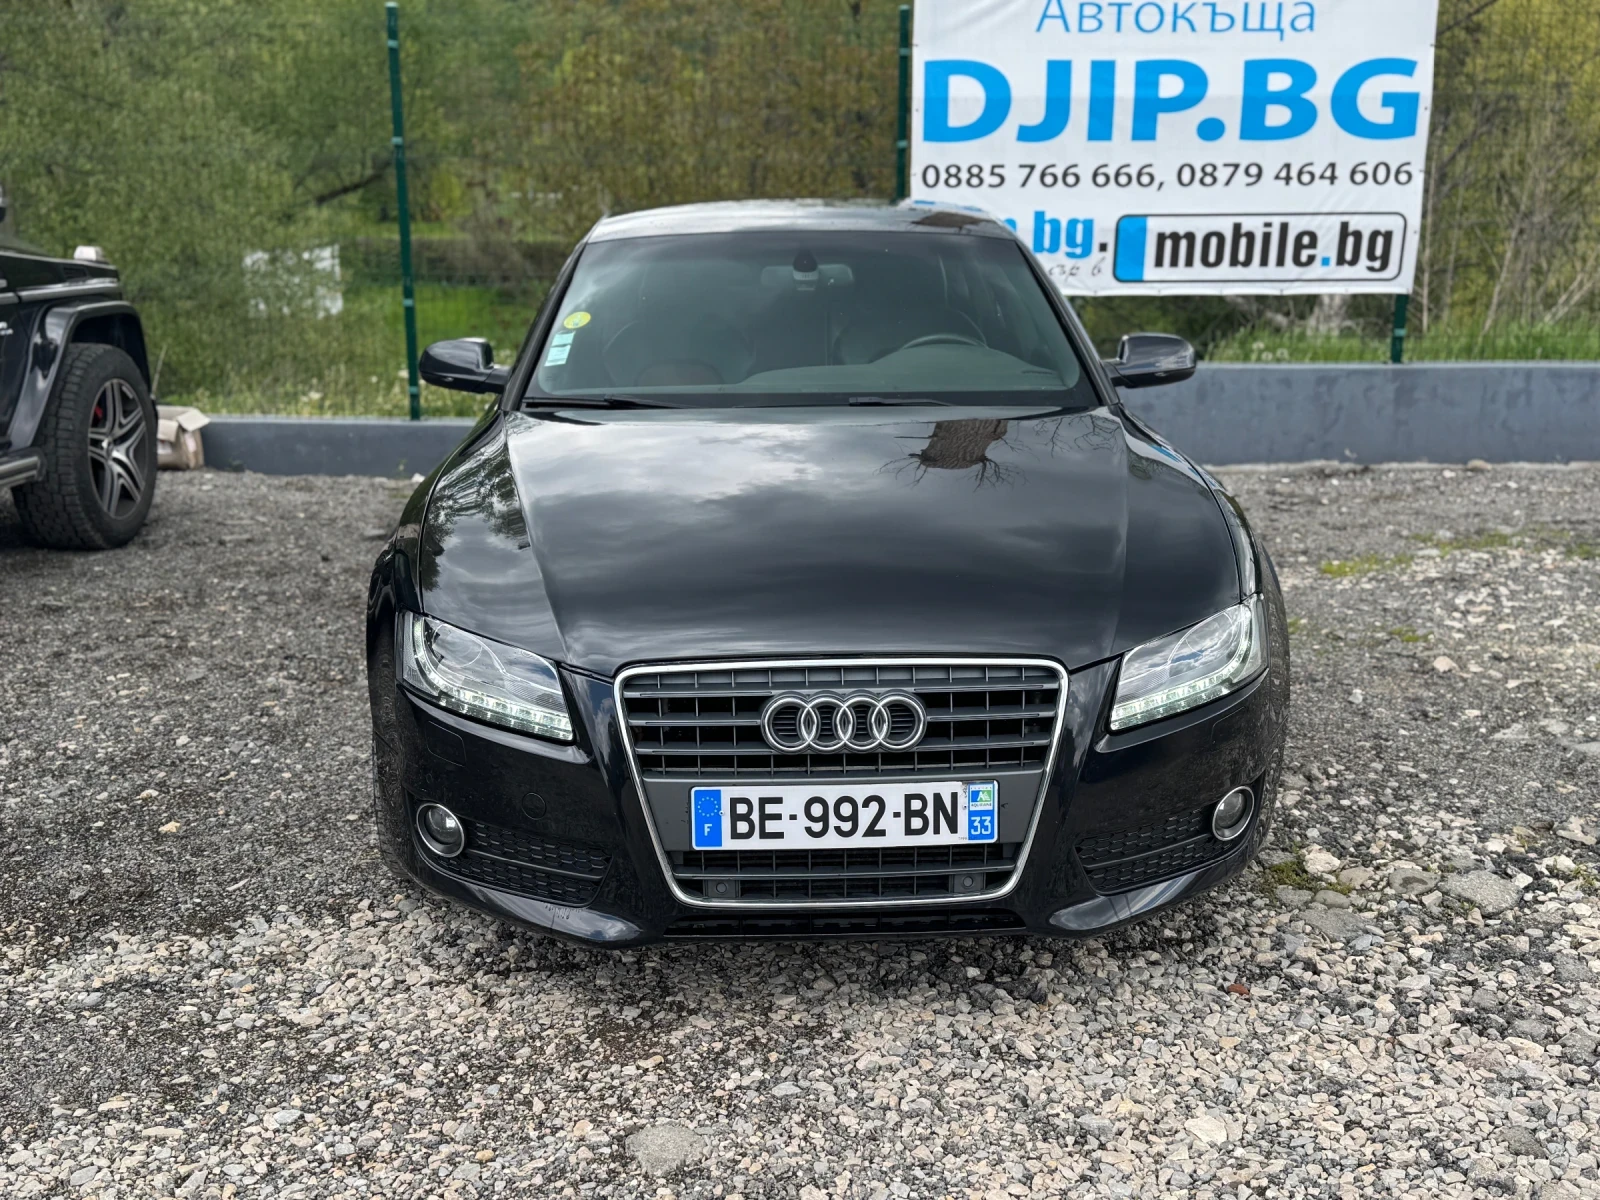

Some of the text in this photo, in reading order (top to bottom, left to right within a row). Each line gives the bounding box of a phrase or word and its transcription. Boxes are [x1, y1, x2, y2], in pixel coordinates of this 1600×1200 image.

[1034, 0, 1317, 42] Автокъща
[922, 57, 1421, 143] DJIP.BG
[921, 161, 1413, 192] 0885 766 666, 0879 464 606
[1154, 220, 1394, 273] mobile.bg
[703, 823, 713, 837] F
[729, 791, 959, 840] BE-992-BN
[970, 815, 992, 835] 33
